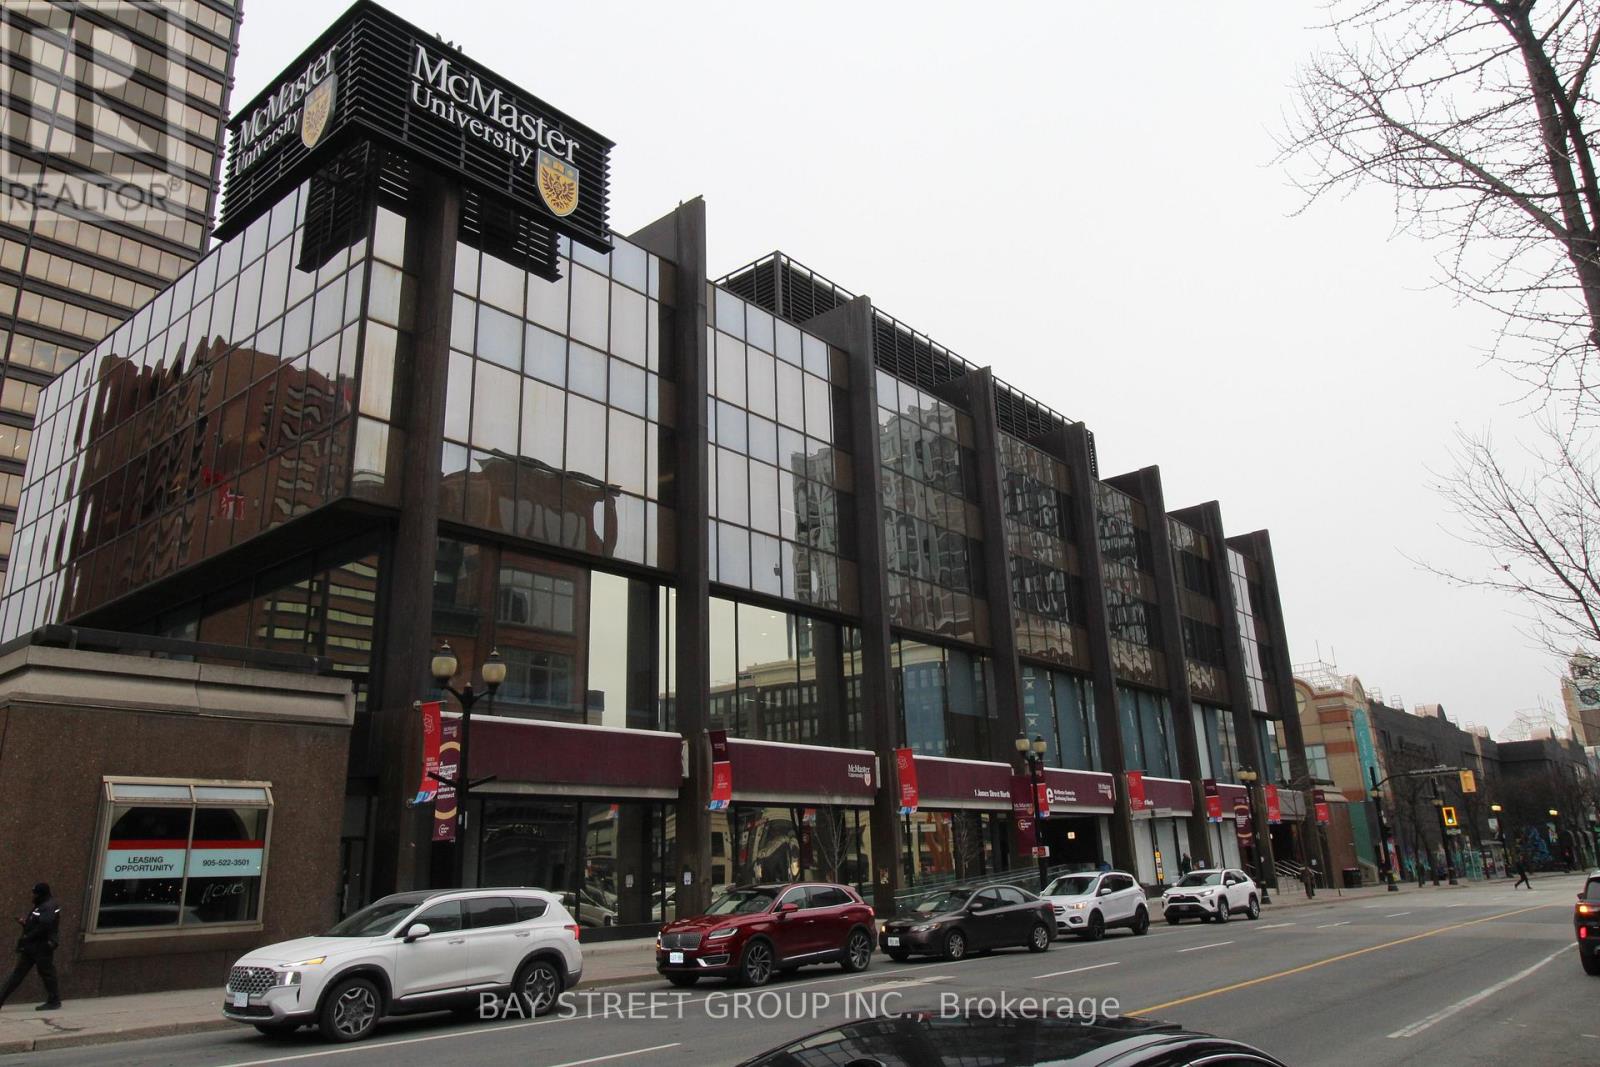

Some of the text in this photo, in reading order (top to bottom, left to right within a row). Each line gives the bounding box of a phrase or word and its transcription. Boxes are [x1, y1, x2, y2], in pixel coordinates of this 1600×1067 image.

[236, 46, 337, 155] McMaster
[411, 80, 534, 167] University
[412, 43, 580, 164] McMaster
[234, 107, 303, 177] University
[114, 864, 175, 873] OPPORTUNITY
[127, 856, 164, 864] LEASING
[202, 859, 250, 867] 905-522-3501
